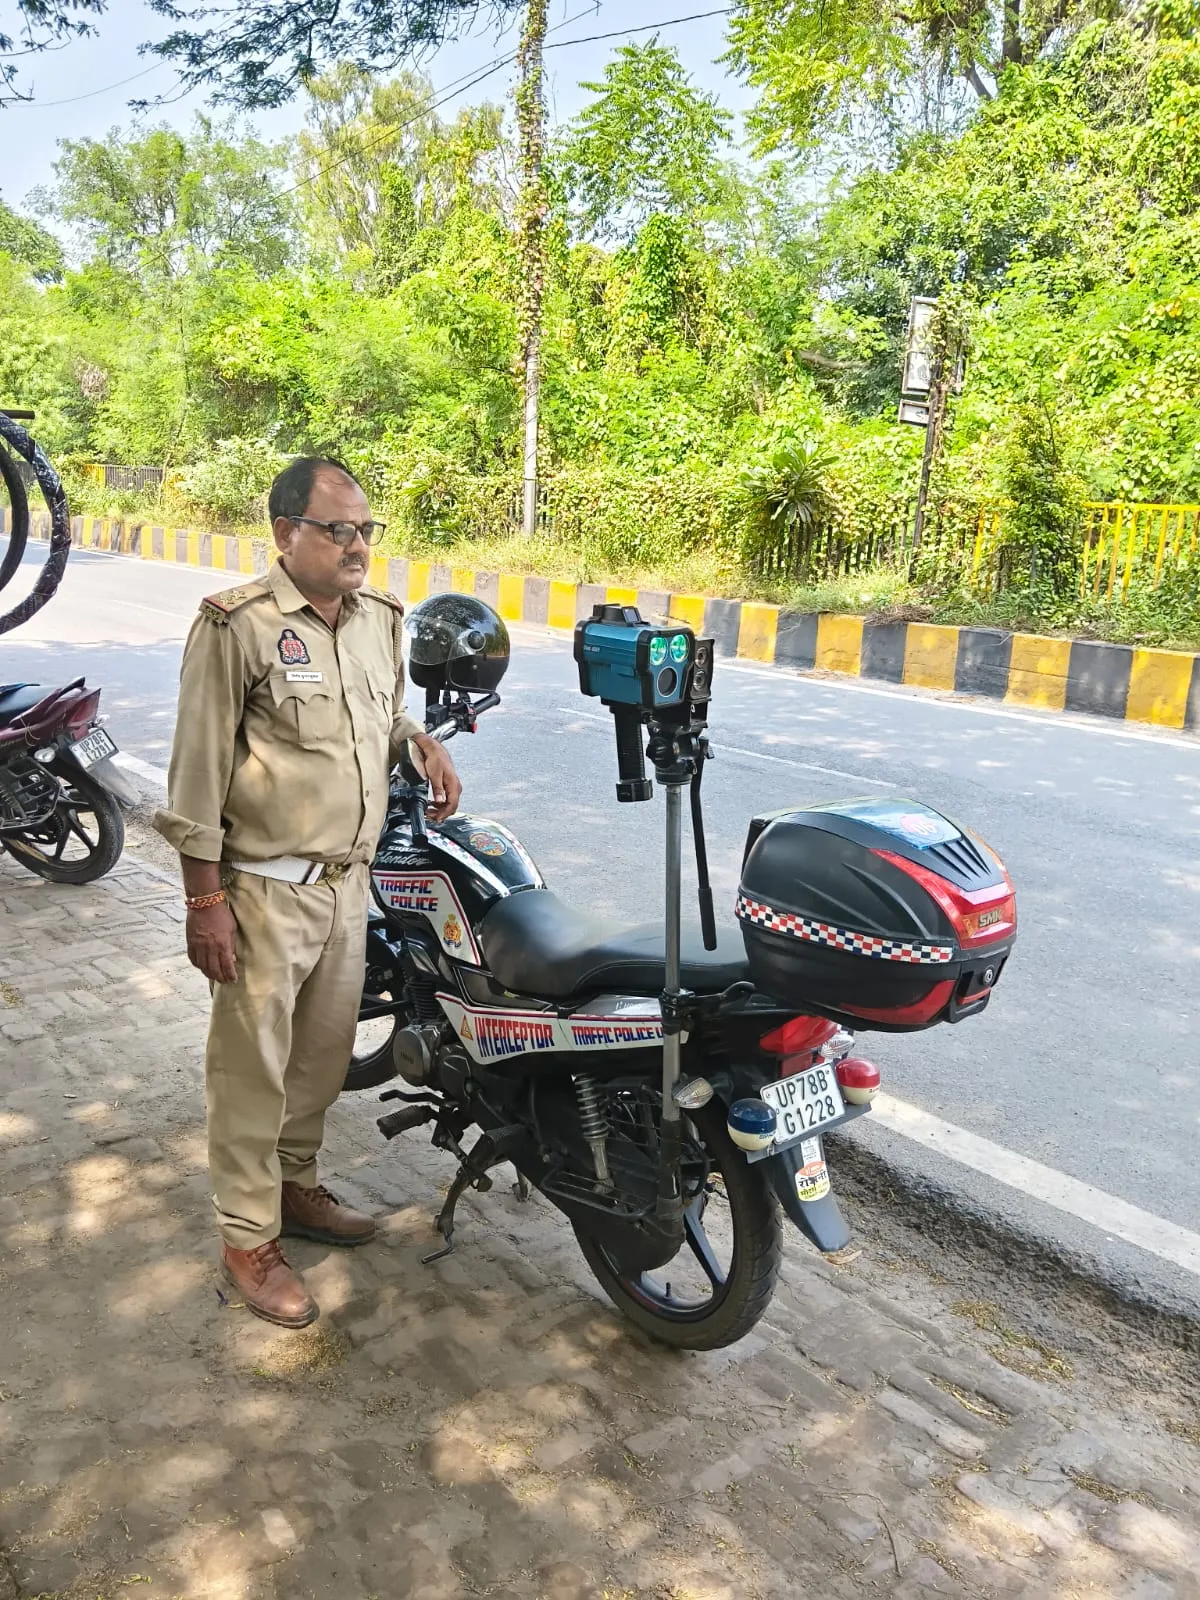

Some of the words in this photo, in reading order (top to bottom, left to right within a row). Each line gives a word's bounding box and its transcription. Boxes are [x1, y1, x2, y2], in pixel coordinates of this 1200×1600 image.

[381, 879, 435, 894] TRAFFIC
[390, 895, 439, 911] POLICE
[474, 1016, 555, 1058] INTERCEPTOR
[571, 1025, 614, 1045] TRAFFIC
[613, 1026, 655, 1043] POLICE
[775, 1069, 828, 1108] UP78B
[784, 1095, 836, 1135] G1228
